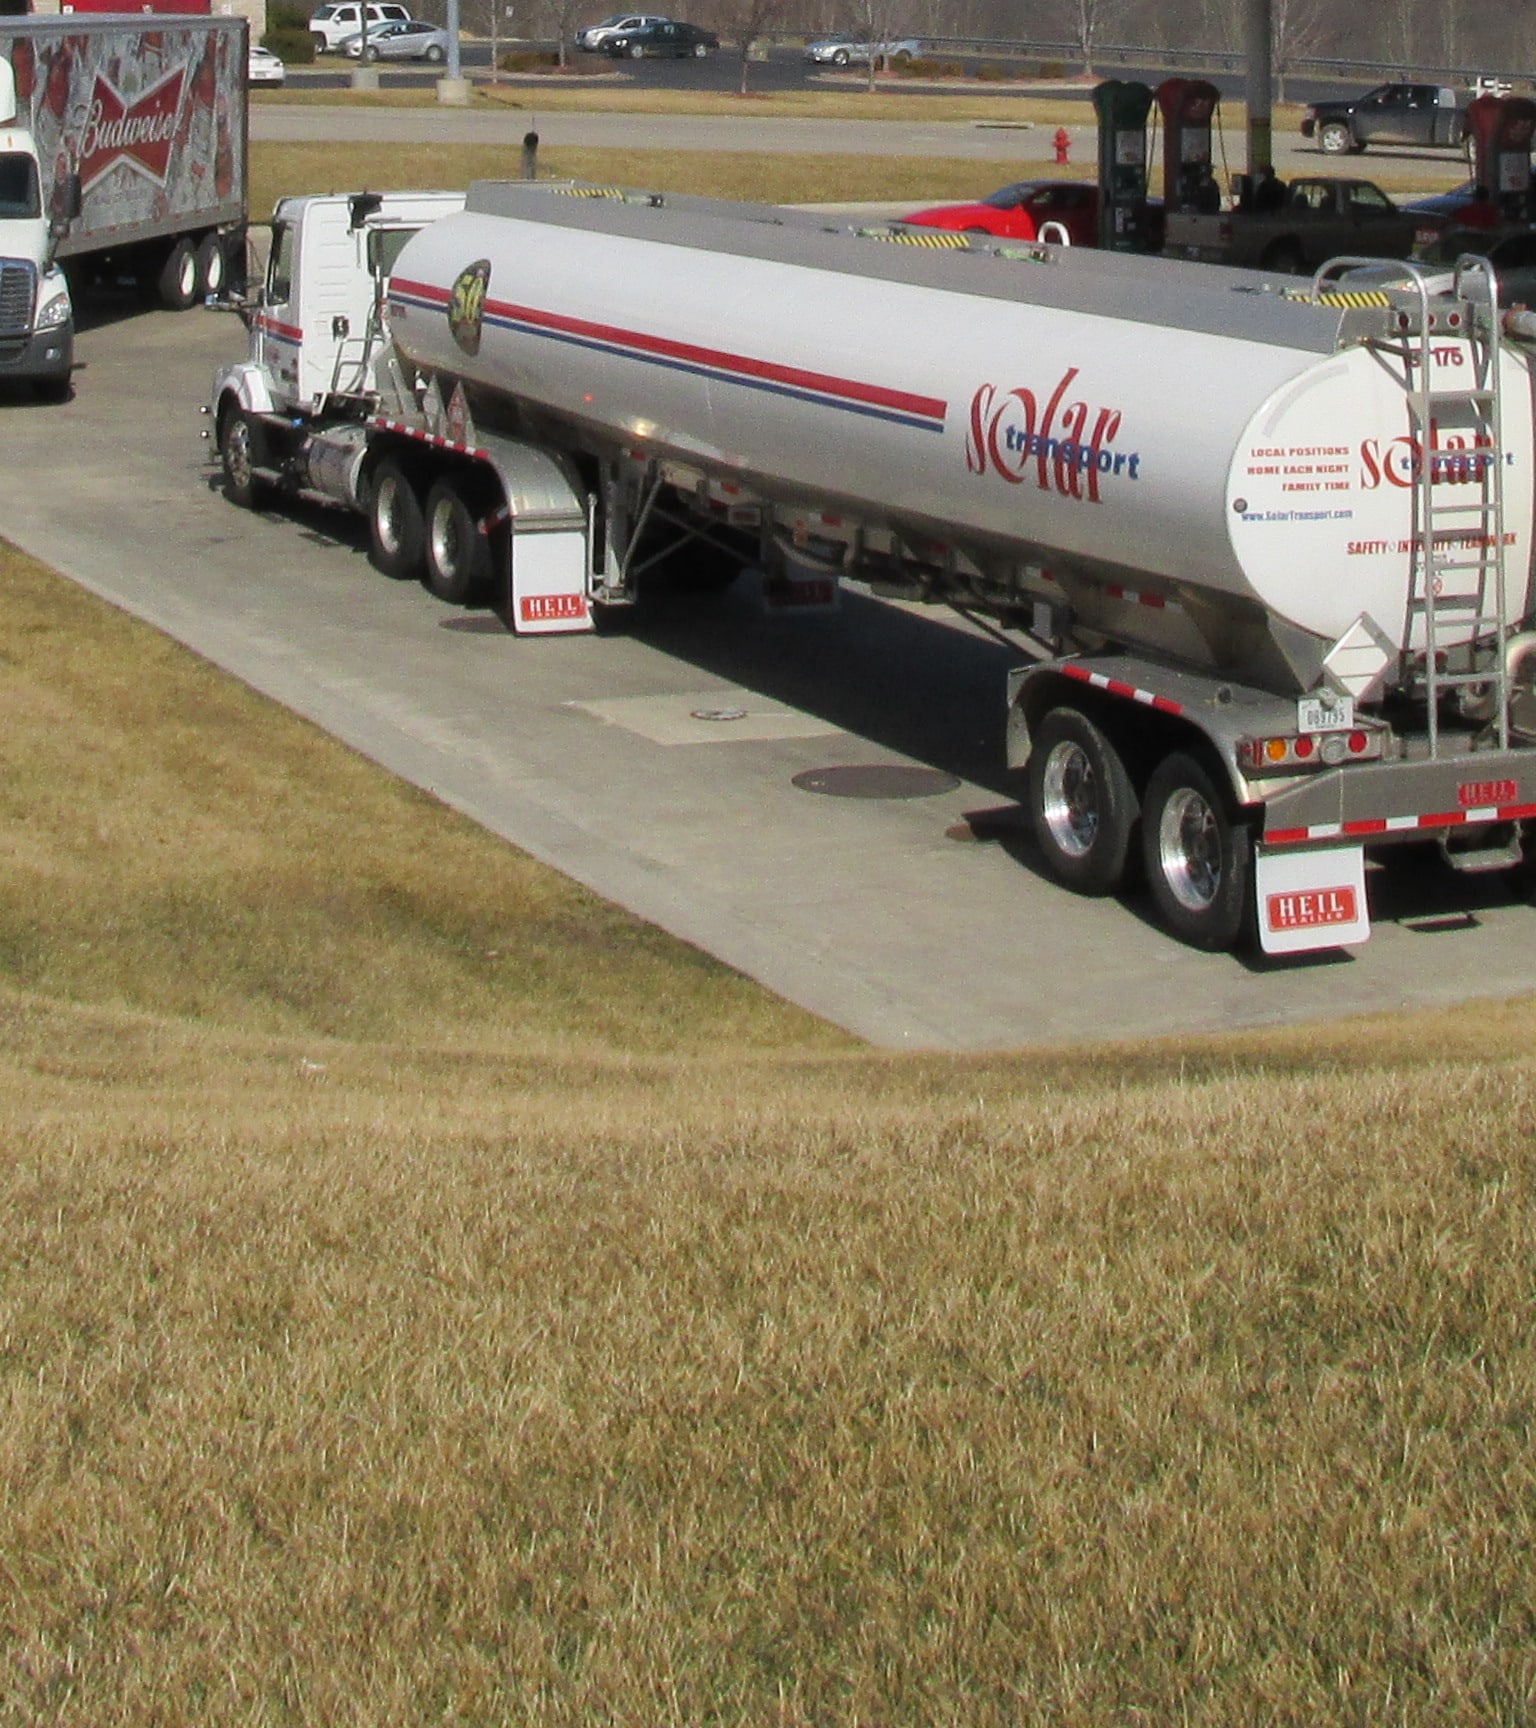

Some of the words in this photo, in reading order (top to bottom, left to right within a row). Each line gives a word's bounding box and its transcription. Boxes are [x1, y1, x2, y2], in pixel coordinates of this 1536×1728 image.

[1005, 424, 1140, 480] transport
[1250, 448, 1286, 457] LOCAL
[1289, 446, 1349, 456] POSITIONS
[1247, 465, 1280, 475] HOME
[1284, 465, 1313, 474] EACH
[1316, 464, 1349, 473] NIGHT
[1282, 482, 1321, 491] FAMILY
[1324, 481, 1350, 490] TIME
[1347, 540, 1388, 555] SAFETY
[529, 597, 577, 612] HEIL
[1279, 892, 1345, 918] HEIL
